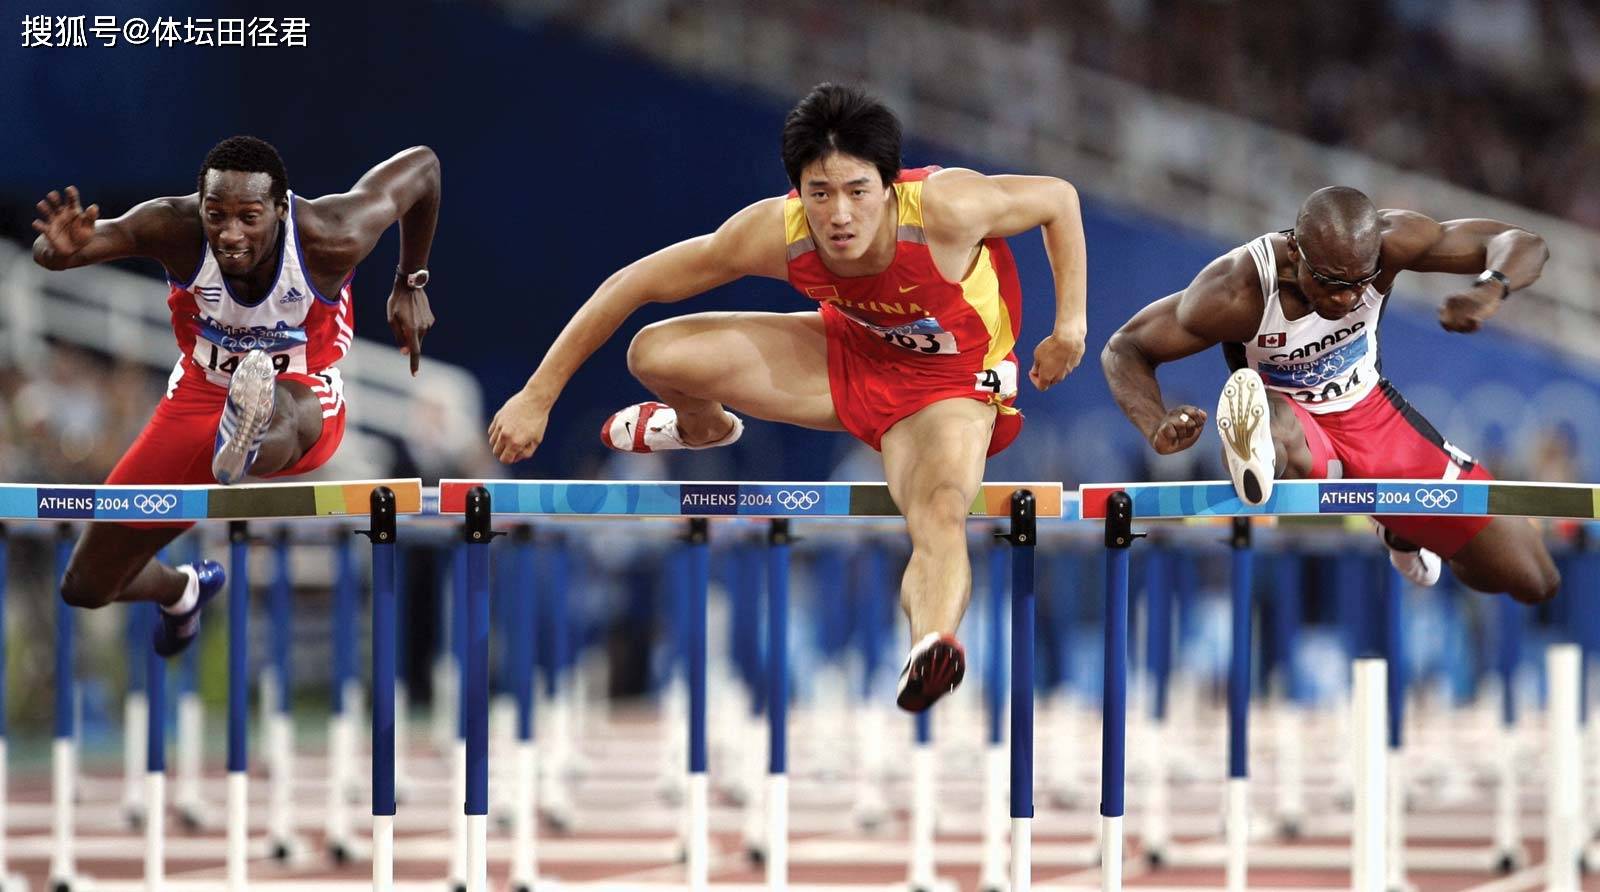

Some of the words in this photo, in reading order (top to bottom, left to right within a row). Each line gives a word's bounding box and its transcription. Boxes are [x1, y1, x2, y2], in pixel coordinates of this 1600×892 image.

[1269, 321, 1365, 361] CANADA
[208, 343, 290, 374] 149
[981, 369, 1001, 393] 4
[39, 497, 93, 510] ATHENS
[96, 498, 129, 510] 2004
[682, 494, 737, 505] ATHENS
[740, 494, 773, 506] 2004
[1320, 492, 1375, 504] ATHENS
[1378, 492, 1411, 504] 2004
